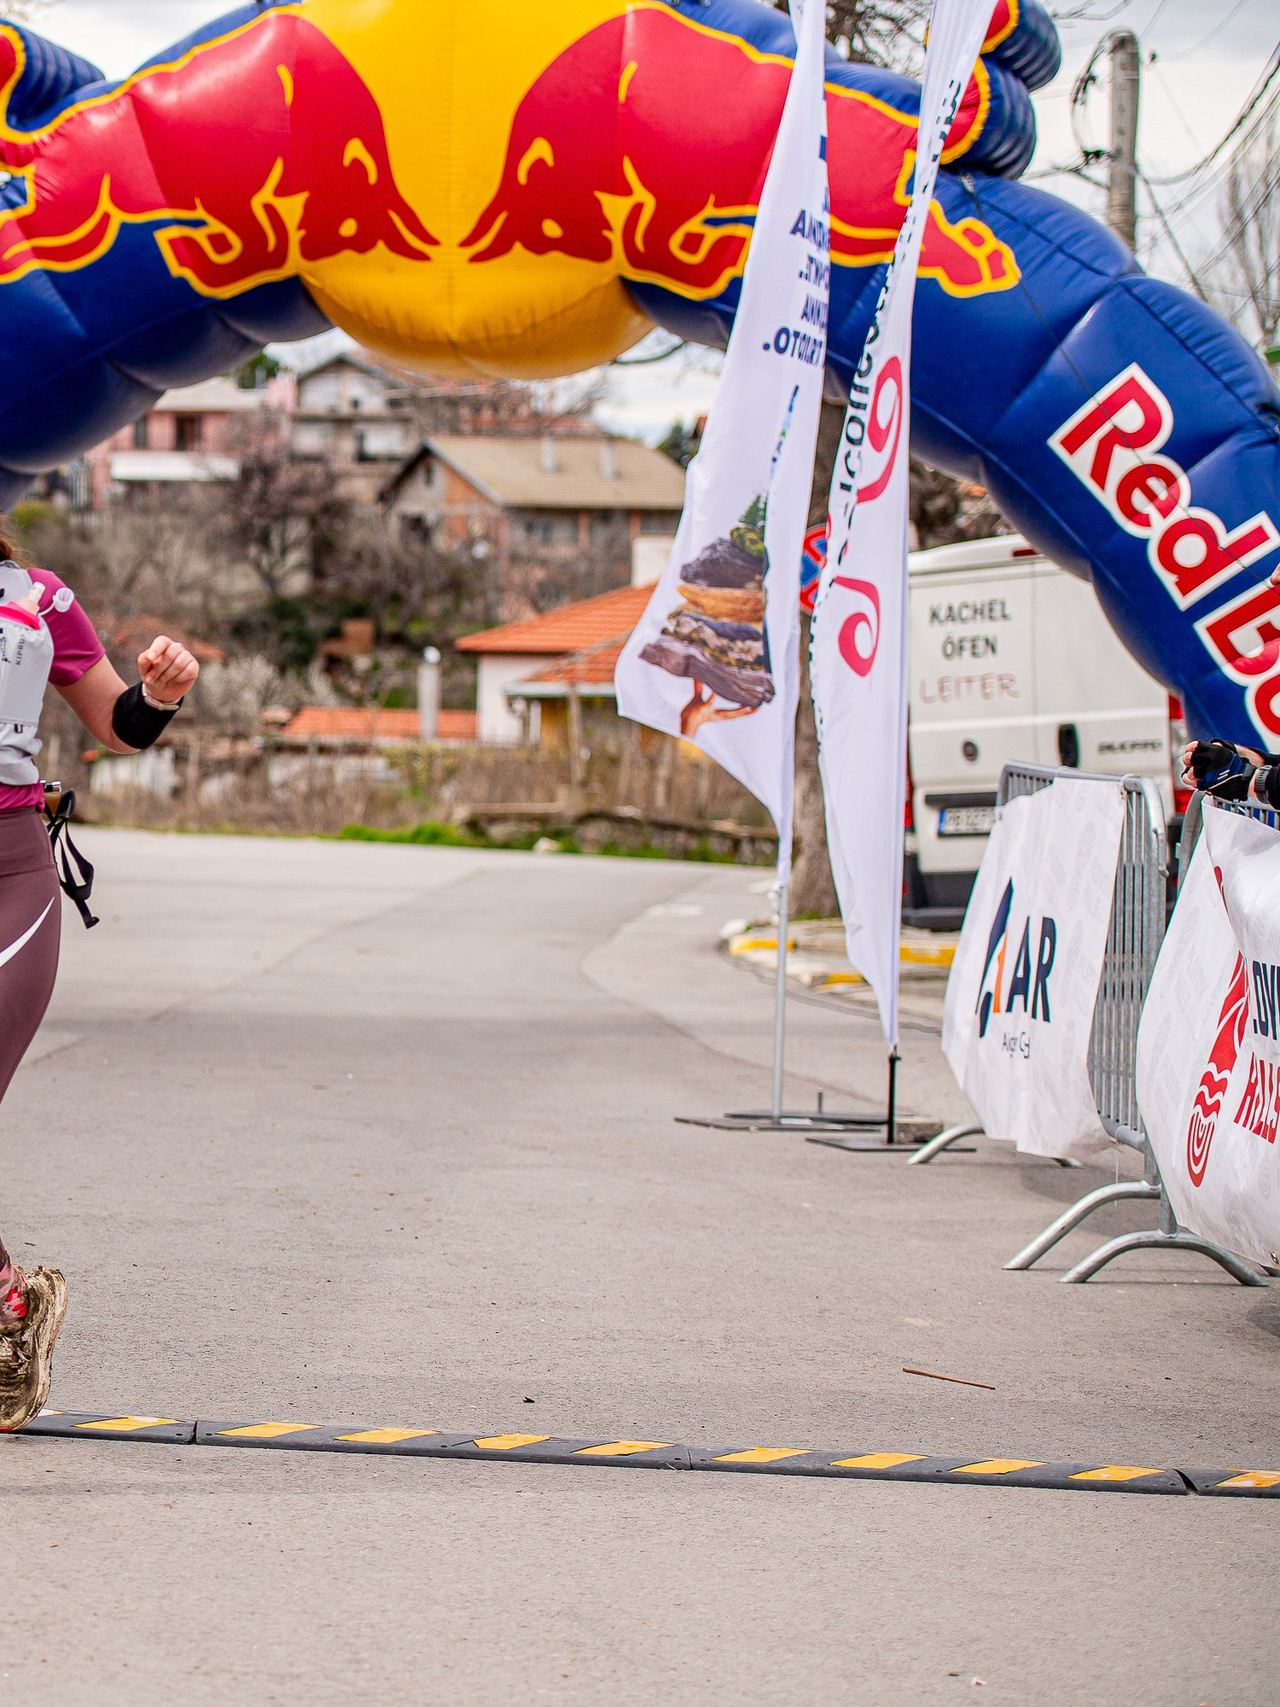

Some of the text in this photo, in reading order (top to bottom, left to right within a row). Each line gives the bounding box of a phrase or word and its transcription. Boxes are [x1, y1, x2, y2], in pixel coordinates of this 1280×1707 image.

[1058, 374, 1272, 600] Red
[928, 598, 1012, 627] KACHEL
[919, 671, 1021, 705] LEITER
